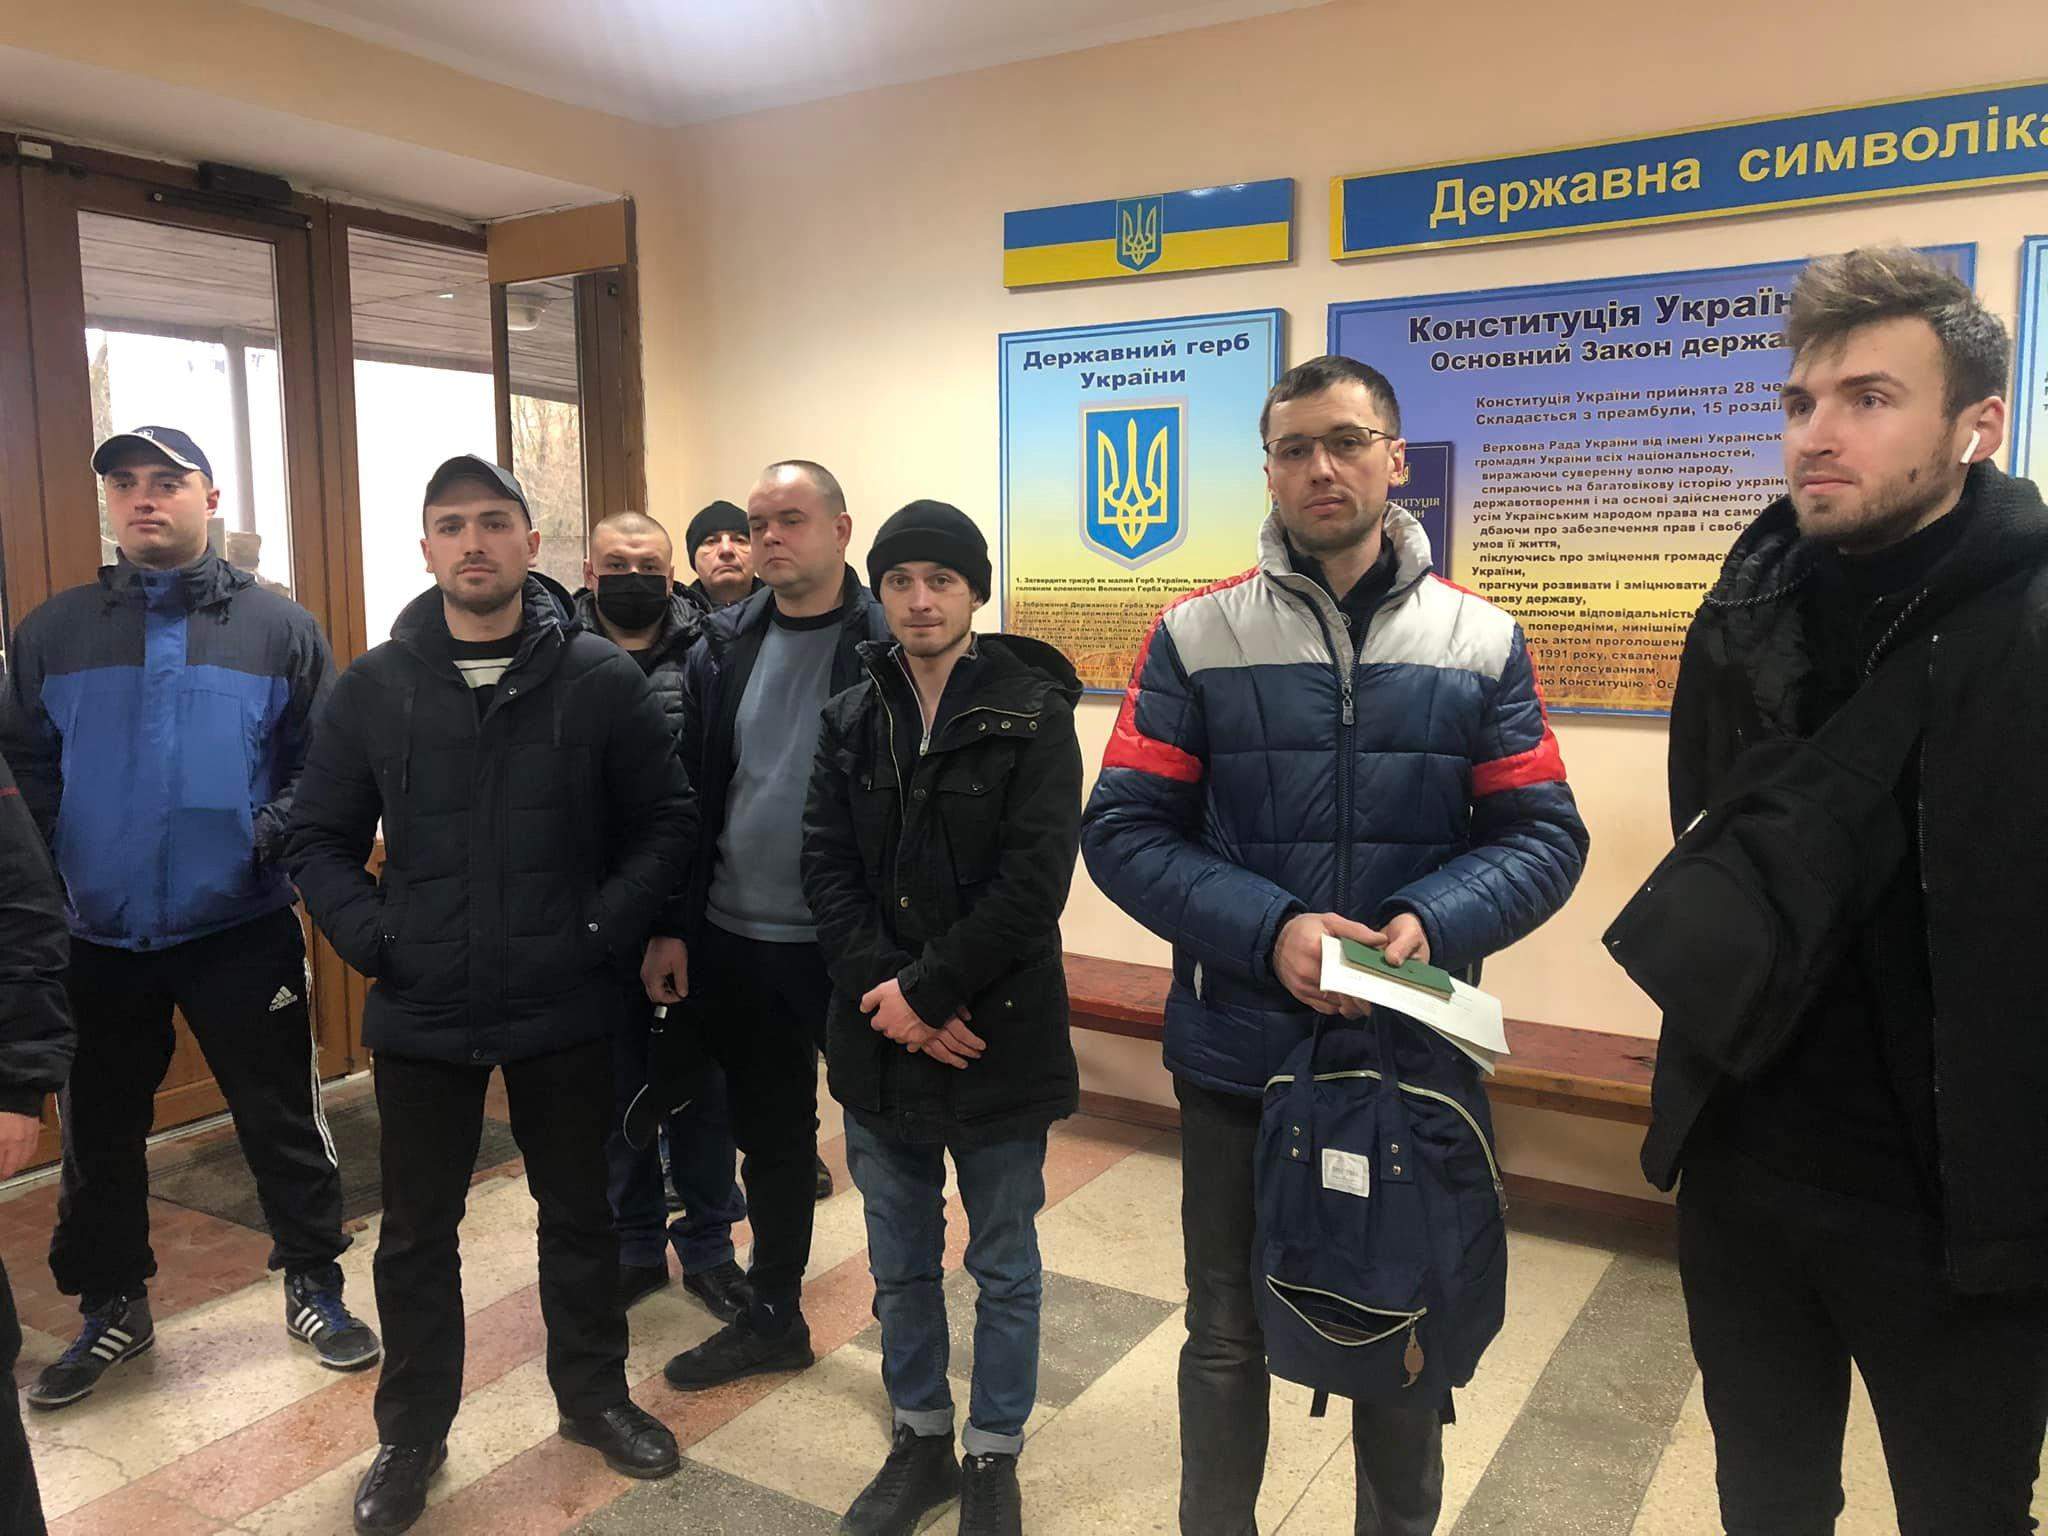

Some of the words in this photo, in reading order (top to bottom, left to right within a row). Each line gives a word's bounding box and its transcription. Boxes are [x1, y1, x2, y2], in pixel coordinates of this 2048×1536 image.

[1429, 156, 1702, 229] Державна
[1408, 300, 1642, 344] Конституція
[1023, 339, 1176, 371] Державний
[1186, 333, 1251, 356] герб
[1430, 343, 1572, 372] Основний
[1581, 338, 1672, 362] Закон
[1081, 367, 1186, 391] України
[1476, 392, 1571, 408] Конституція
[1576, 389, 1641, 404] України
[1646, 384, 1728, 400] прийнята
[1734, 381, 1755, 394] 28
[1761, 383, 1785, 393] че
[1476, 412, 1577, 425] Складається
[1583, 411, 1592, 420] з
[1597, 405, 1696, 421] преамбули,
[1702, 402, 1722, 414] 15
[1483, 443, 1545, 454] Верховна
[1549, 441, 1581, 451] Рада
[1585, 438, 1638, 450] України
[1643, 435, 1662, 447] від
[1667, 434, 1703, 445] імені
[1708, 432, 1784, 445] Українськ
[1475, 456, 1536, 468] громадян
[1540, 454, 1591, 466] України
[1596, 452, 1622, 463] всіх
[1627, 447, 1755, 462] національностей,
[1482, 471, 1557, 482] виражаючи
[1562, 467, 1632, 479] суверенну
[1637, 466, 1674, 475] волю
[1678, 464, 1733, 476] народу,
[1481, 484, 1562, 495] спираючись
[1566, 483, 1582, 491] на
[1587, 479, 1674, 491] багатовікову
[1678, 478, 1731, 489] історію
[1473, 497, 1590, 509] державотворення
[1594, 496, 1598, 505] і
[1602, 496, 1618, 505] на
[1623, 494, 1668, 504] основі
[1673, 492, 1762, 504] здійсненого
[1473, 511, 1501, 523] усім
[1505, 511, 1589, 521] Українським
[1593, 510, 1652, 520] народом
[1657, 509, 1698, 519] права
[1702, 508, 1719, 517] на
[1724, 508, 1765, 517] само
[1480, 525, 1530, 536] дбаючи
[1534, 526, 1557, 536] про
[1562, 523, 1659, 534] забезпечення
[1663, 523, 1696, 534] прав
[1700, 522, 1704, 531] і
[1472, 541, 1503, 551] умов
[1507, 540, 1515, 549] її
[1519, 540, 1561, 549] життя,
[1480, 553, 1556, 564] піклуючись
[1559, 553, 1583, 564] про
[1588, 551, 1660, 562] зміцнення
[1472, 567, 1526, 577] України,
[1479, 582, 1538, 591] прагнучи
[1542, 581, 1611, 591] розвивати
[1615, 580, 1619, 589] і
[1624, 580, 1707, 591] зміцнювати
[1526, 595, 1587, 605] державу,
[1506, 609, 1575, 617] омлюючи
[1579, 608, 1694, 618] відповідальність
[1528, 622, 1618, 633] попередніми,
[1552, 637, 1591, 645] актом
[1539, 649, 1568, 658] 1991
[1573, 651, 1607, 661] року,
[1612, 653, 1680, 661] схвалени
[1560, 664, 1660, 675] голосуванням,
[1559, 677, 1644, 689] Конституцію
